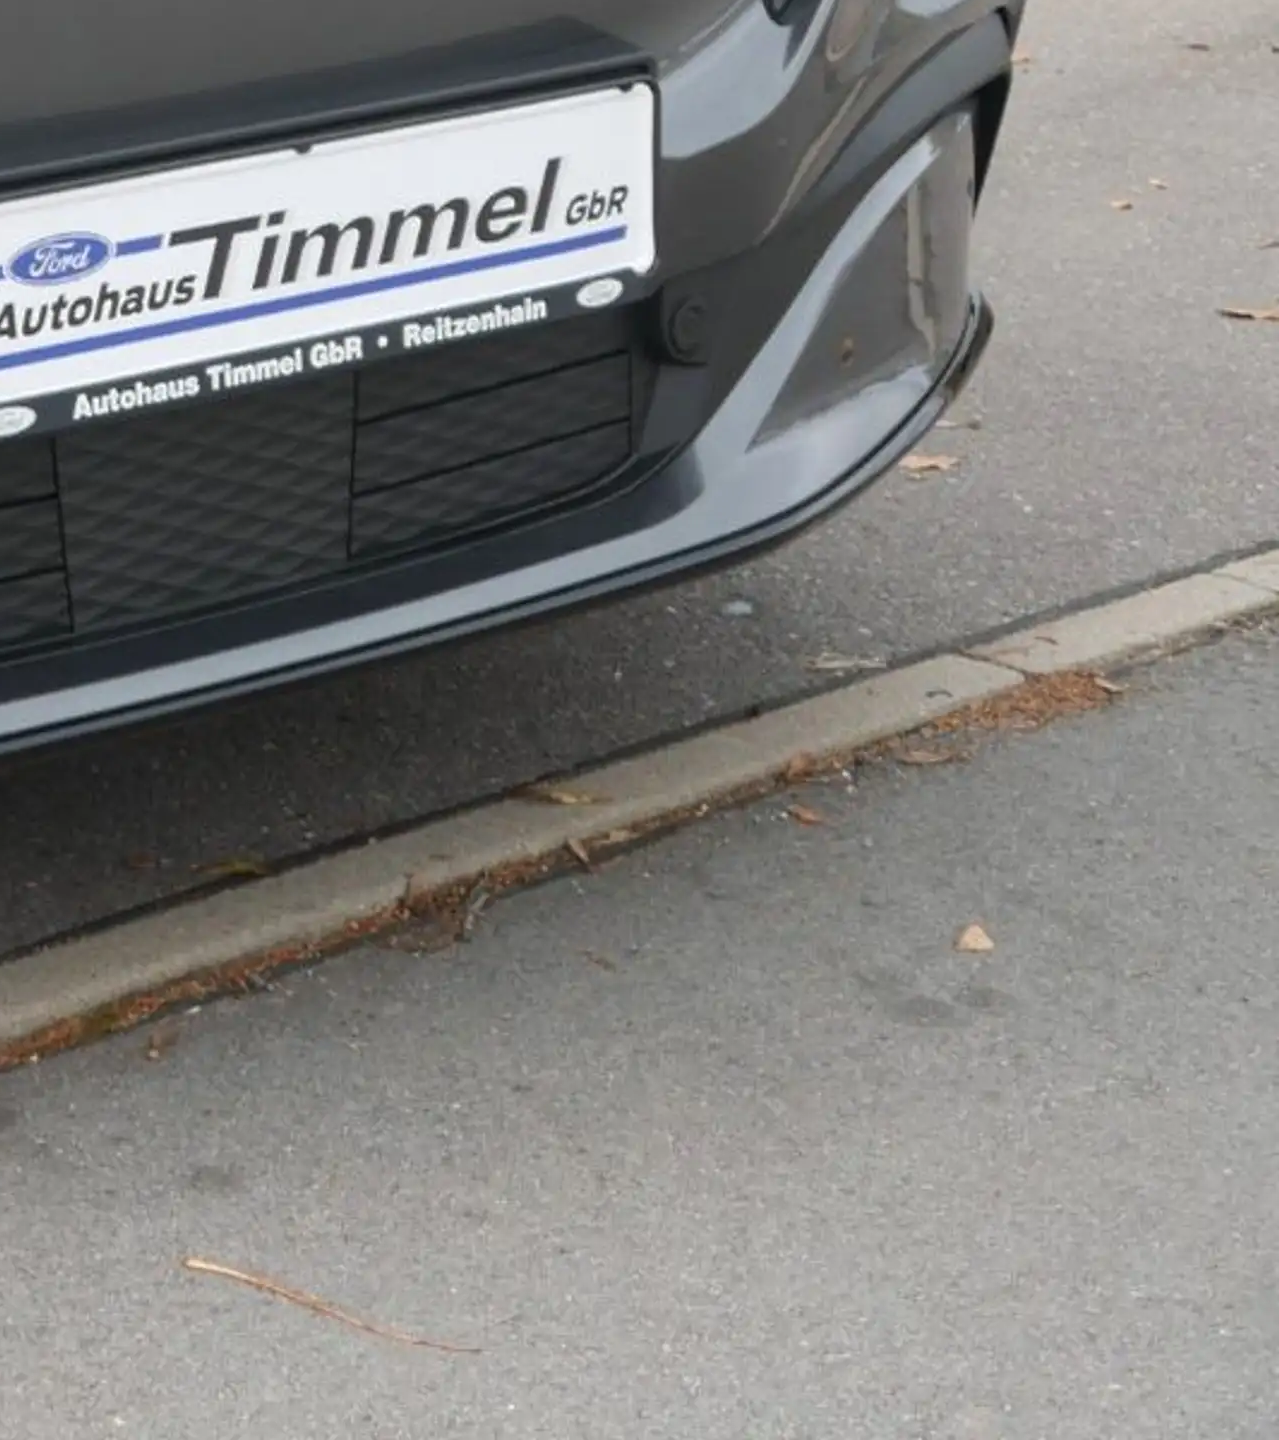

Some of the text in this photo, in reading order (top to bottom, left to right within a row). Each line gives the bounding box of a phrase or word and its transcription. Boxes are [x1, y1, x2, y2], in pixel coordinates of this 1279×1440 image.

[168, 156, 563, 300] Timmel
[564, 184, 630, 226] GbR
[72, 373, 201, 422] Autohaus
[205, 347, 304, 392] Timmel
[309, 335, 364, 370] GbR
[402, 297, 548, 349] Reitzenhain
